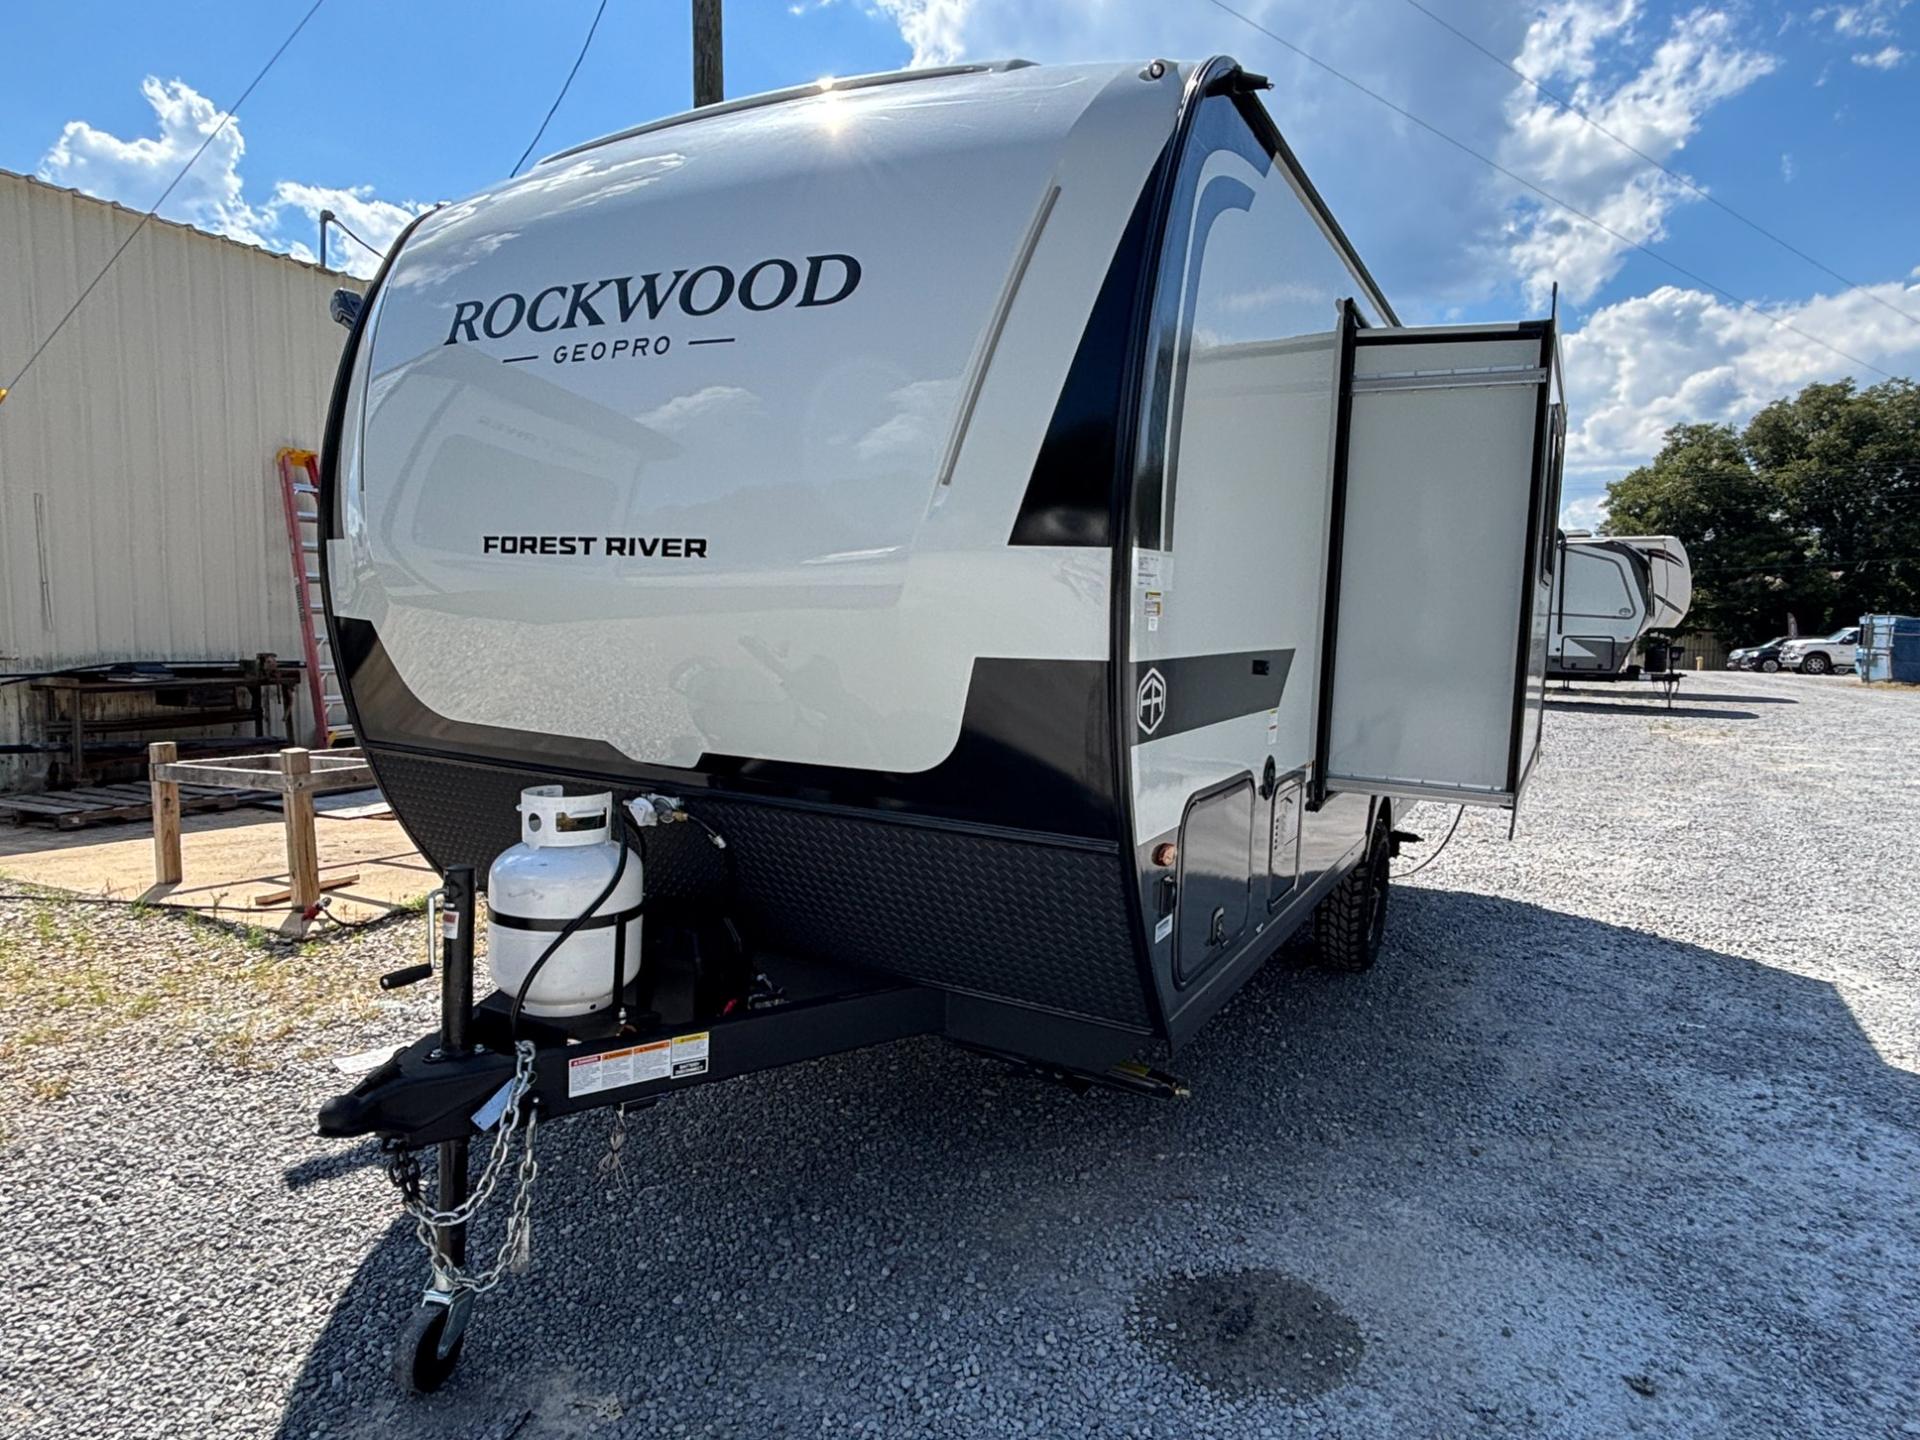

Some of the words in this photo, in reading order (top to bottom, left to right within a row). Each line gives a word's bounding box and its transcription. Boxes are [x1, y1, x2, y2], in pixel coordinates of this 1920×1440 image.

[443, 254, 862, 346] ROCKWOOD
[553, 335, 671, 364] GEOPRO
[483, 536, 598, 555] FOREST
[605, 537, 707, 558] RIVER
